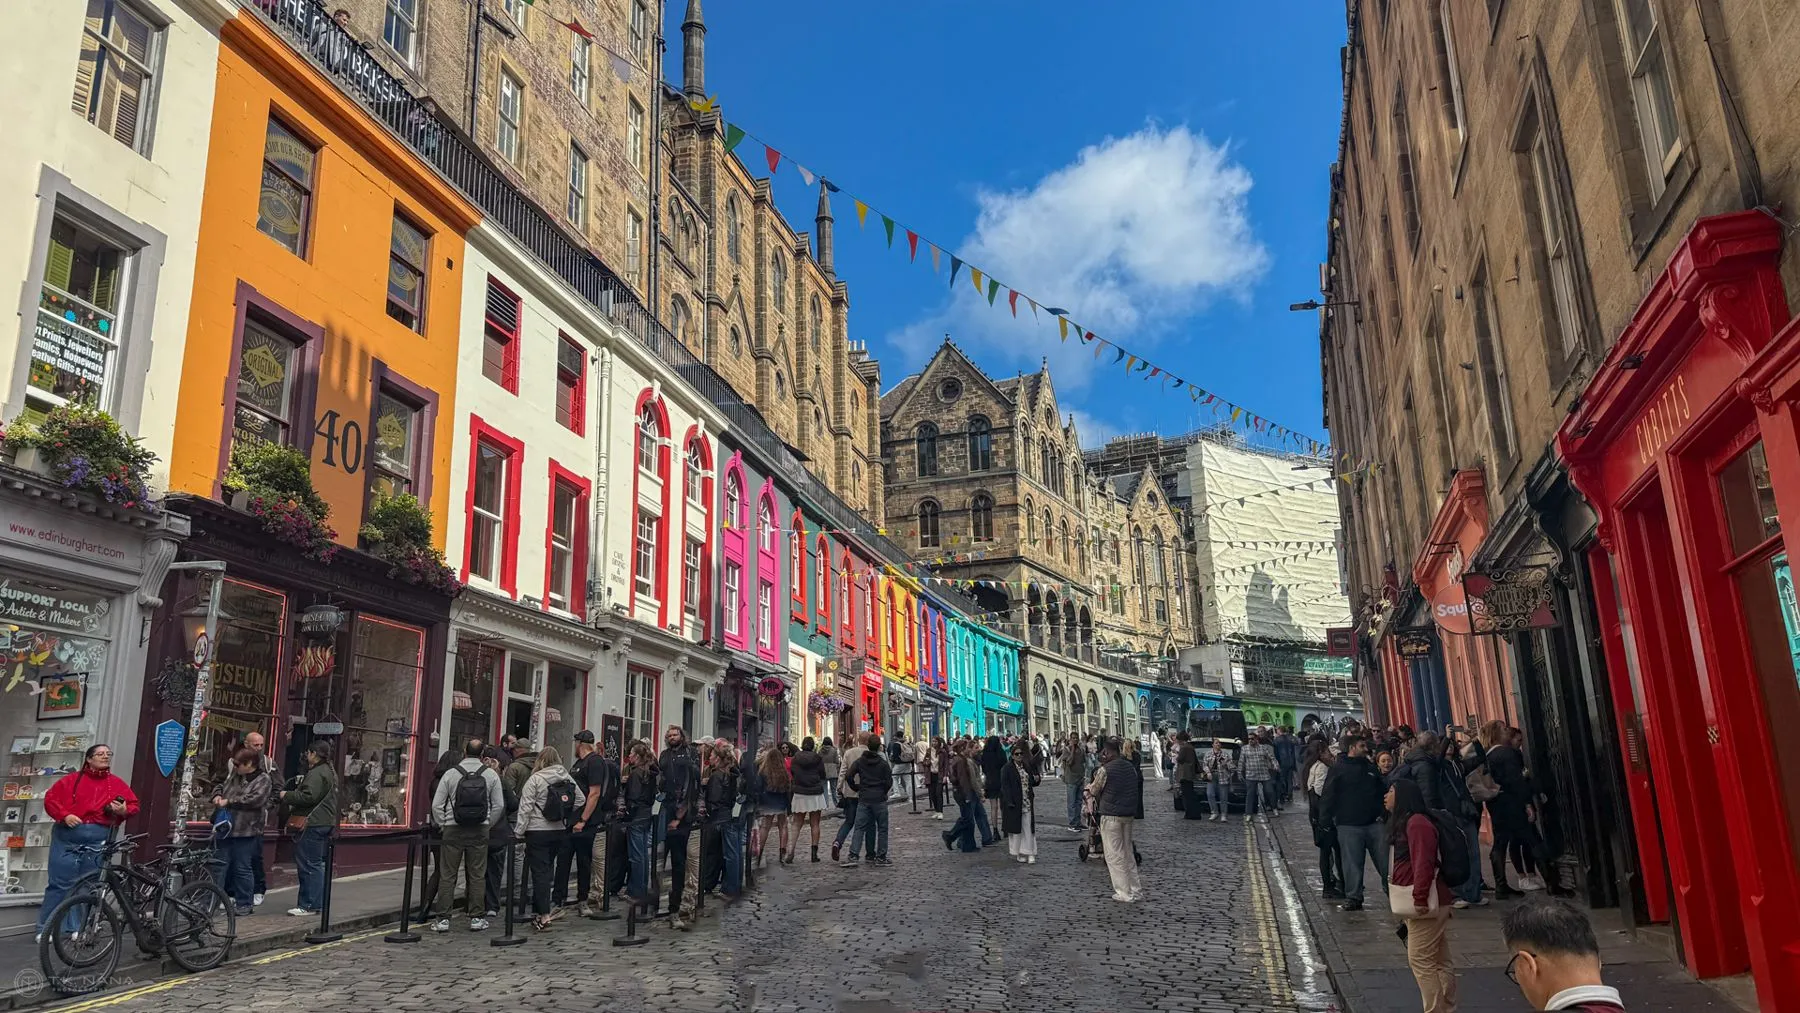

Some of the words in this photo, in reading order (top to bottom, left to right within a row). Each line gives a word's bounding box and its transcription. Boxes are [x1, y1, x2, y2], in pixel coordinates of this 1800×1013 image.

[33, 337, 62, 357] ramics,
[63, 349, 104, 374] Homeware
[42, 328, 67, 347] Prints,
[68, 339, 104, 364] Jewellery,
[31, 349, 57, 366] eative
[57, 358, 75, 374] Gifts
[75, 366, 82, 376] &
[82, 368, 105, 385] Cards
[247, 352, 282, 379] ORIGINAL
[1635, 374, 1691, 465] CUBITTS
[315, 409, 362, 475] 40
[0, 587, 57, 608] SUPPORT
[59, 600, 90, 614] LOCAL
[4, 602, 38, 619] Artists
[38, 610, 47, 621] &
[48, 610, 82, 627] Makers
[213, 662, 269, 697] USEUM
